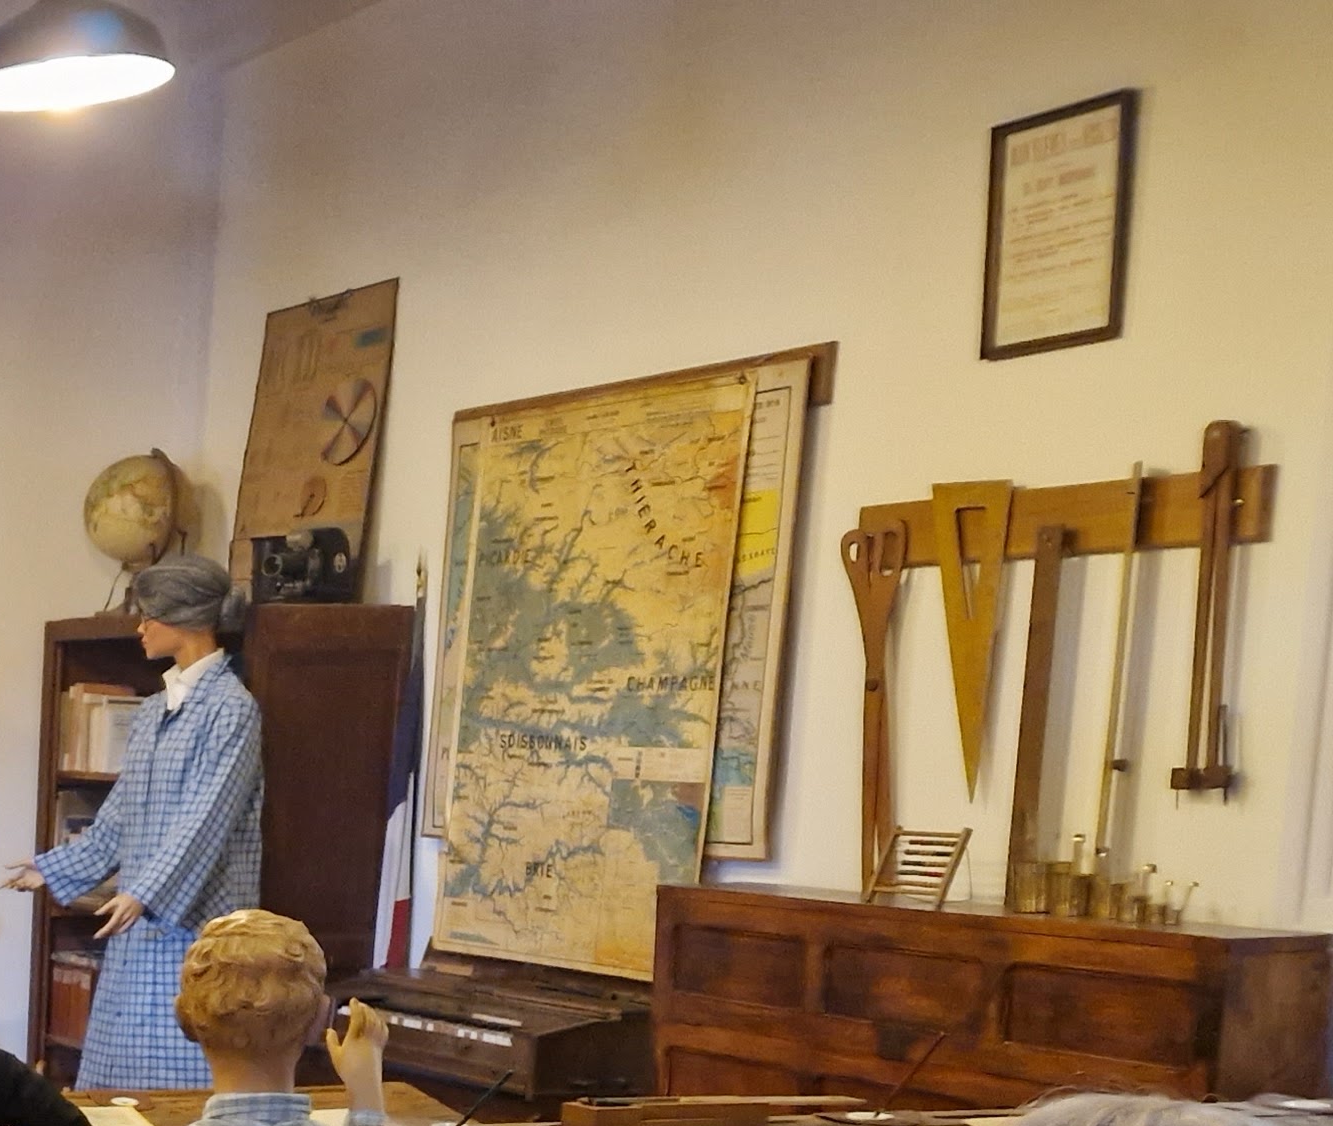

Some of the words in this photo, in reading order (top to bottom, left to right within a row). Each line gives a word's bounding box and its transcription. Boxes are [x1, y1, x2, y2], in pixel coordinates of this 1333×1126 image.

[491, 423, 523, 443] AISNE
[627, 676, 715, 692] CHAMPAGNE
[499, 732, 587, 751] SOISSONNAIS
[526, 862, 553, 878] BRIE
